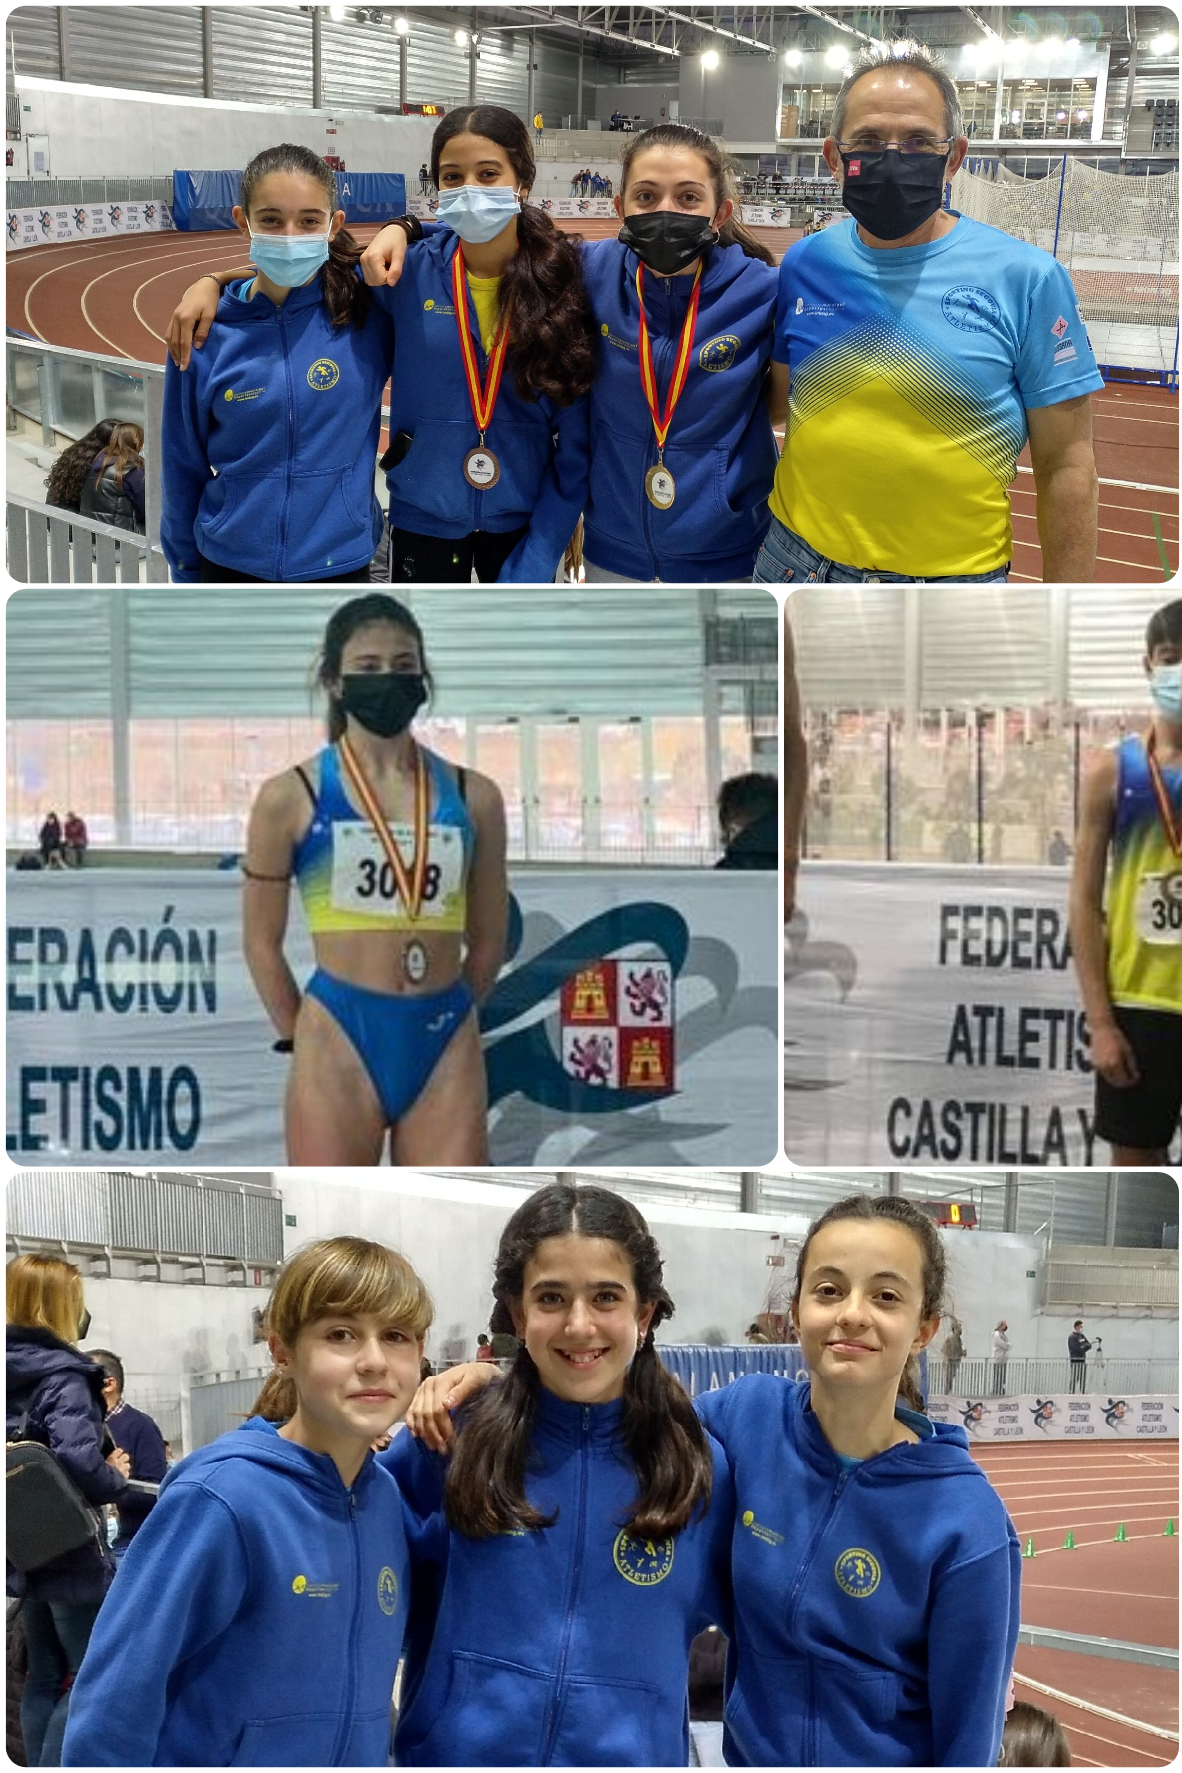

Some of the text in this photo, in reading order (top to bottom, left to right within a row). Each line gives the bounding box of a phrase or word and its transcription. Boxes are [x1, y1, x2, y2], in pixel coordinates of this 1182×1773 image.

[356, 858, 441, 901] 308
[7, 905, 217, 1014] ERACIÓN
[887, 1097, 1067, 1166] CASTILLA
[619, 1559, 669, 1582] ATLETISMO
